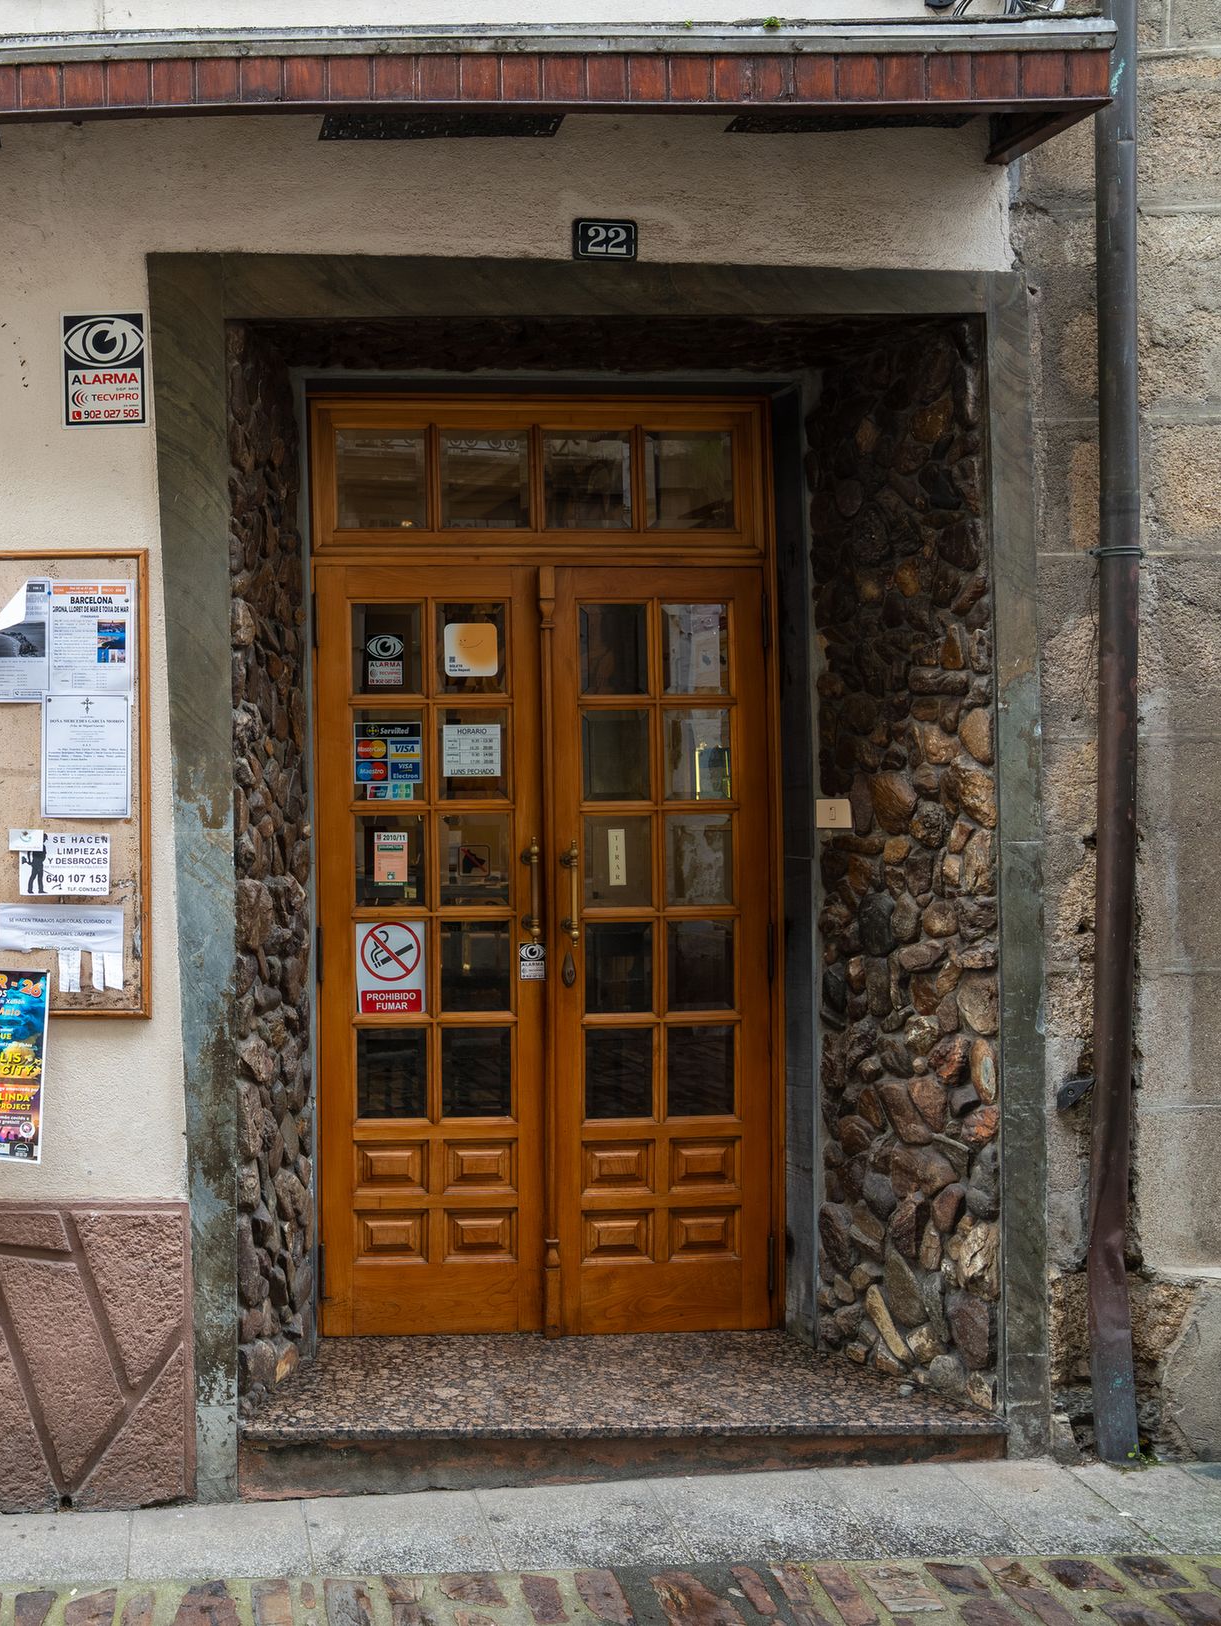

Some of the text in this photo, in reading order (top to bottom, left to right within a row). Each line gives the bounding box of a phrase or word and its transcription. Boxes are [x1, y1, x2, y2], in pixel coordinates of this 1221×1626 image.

[587, 226, 627, 254] 22
[71, 372, 139, 386] ALARMA
[91, 392, 140, 402] TECVIPRO
[83, 408, 140, 420] 902 027 505
[69, 596, 114, 605] BARCELONA
[380, 727, 410, 735] ServiRed
[395, 745, 415, 753] VISA
[52, 836, 108, 844] SE HACEN
[56, 847, 108, 855] LIMPIEZAS
[55, 857, 108, 865] DESBROCES
[45, 874, 107, 883] 640 107 153
[20, 979, 43, 998] 26
[366, 992, 417, 1001] PROHIBIDO
[376, 1001, 408, 1010] FUMAR
[1, 1065, 35, 1077] CITY
